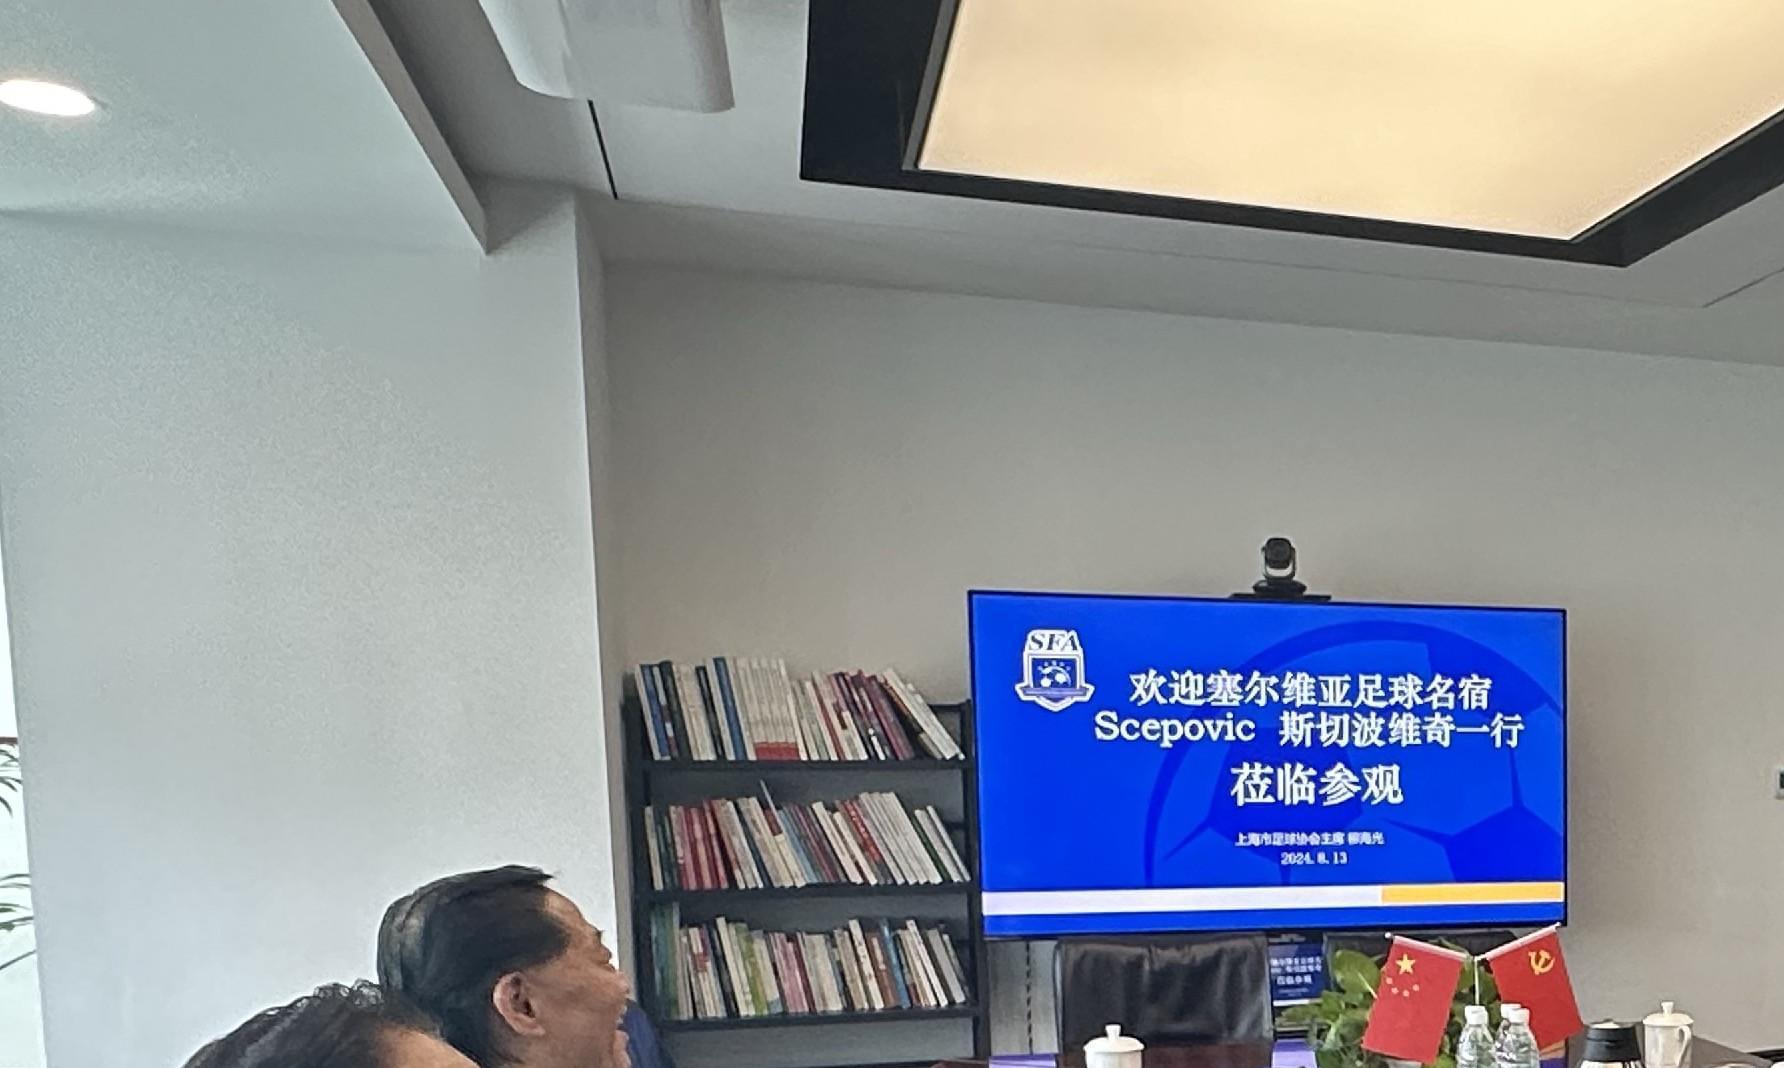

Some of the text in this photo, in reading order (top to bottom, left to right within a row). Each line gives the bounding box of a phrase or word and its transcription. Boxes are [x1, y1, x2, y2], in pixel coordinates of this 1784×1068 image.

[1030, 632, 1079, 651] SFA
[1129, 669, 1493, 710] 欢迎塞尔维亚足球名宿
[1094, 711, 1525, 748] Scepovic 斯切波维奇一行
[1230, 761, 1404, 806] 莅临参观
